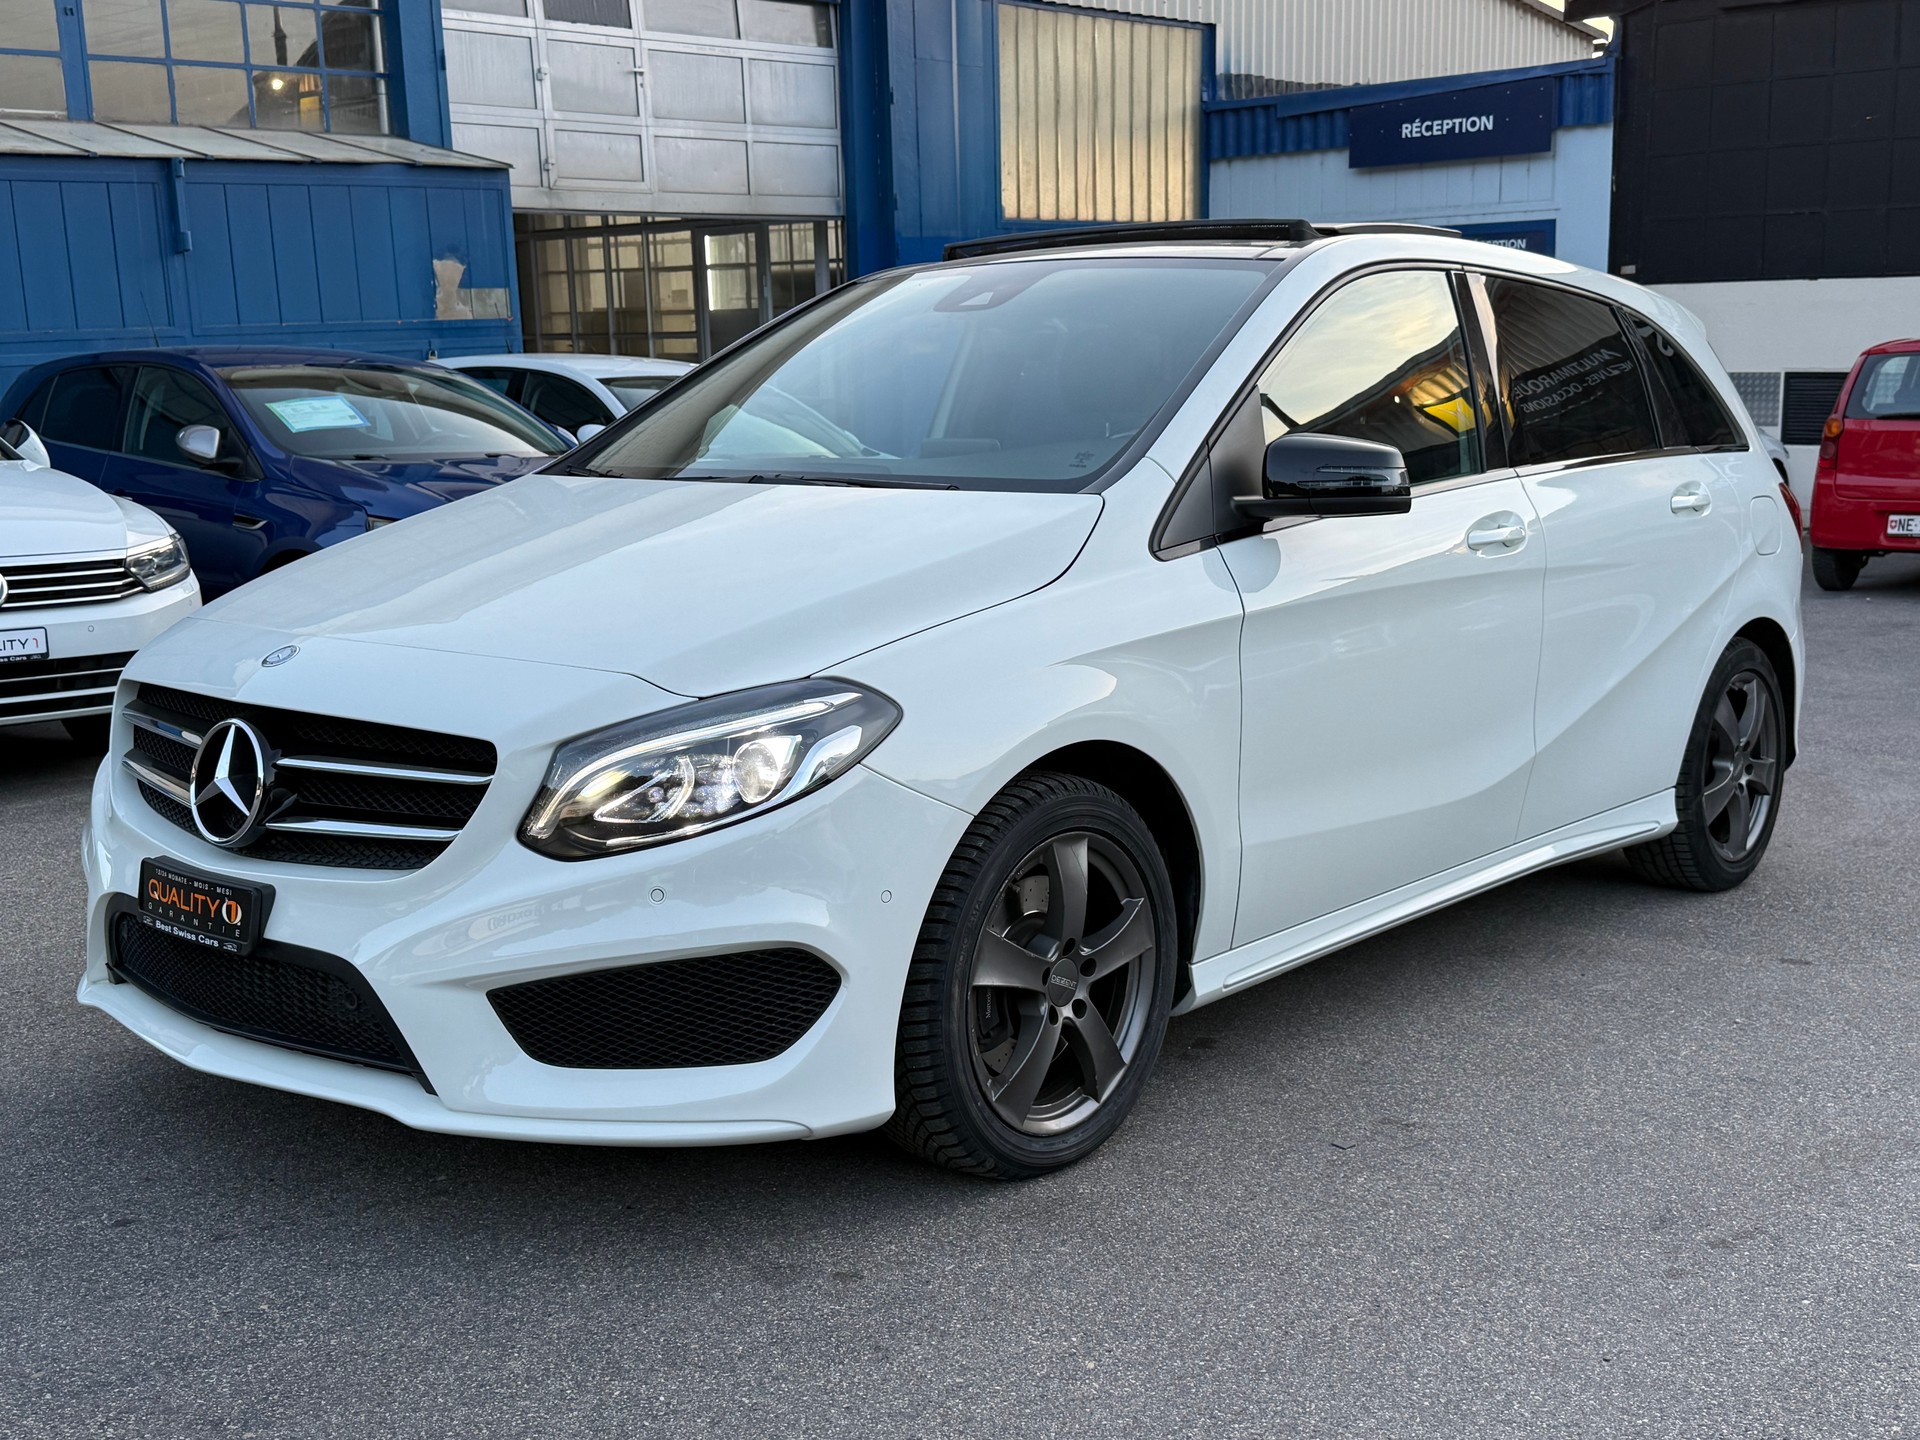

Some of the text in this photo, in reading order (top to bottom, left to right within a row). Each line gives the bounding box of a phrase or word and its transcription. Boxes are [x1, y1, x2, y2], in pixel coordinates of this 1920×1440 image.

[1401, 115, 1494, 139] RÉCEPTION
[148, 878, 220, 919] QUALITY
[193, 880, 209, 891] MOIS
[216, 886, 233, 896] MESI
[148, 902, 241, 938] GARANTIE
[155, 920, 173, 934] Best
[173, 926, 197, 941] Swiss
[199, 934, 219, 948] Cars
